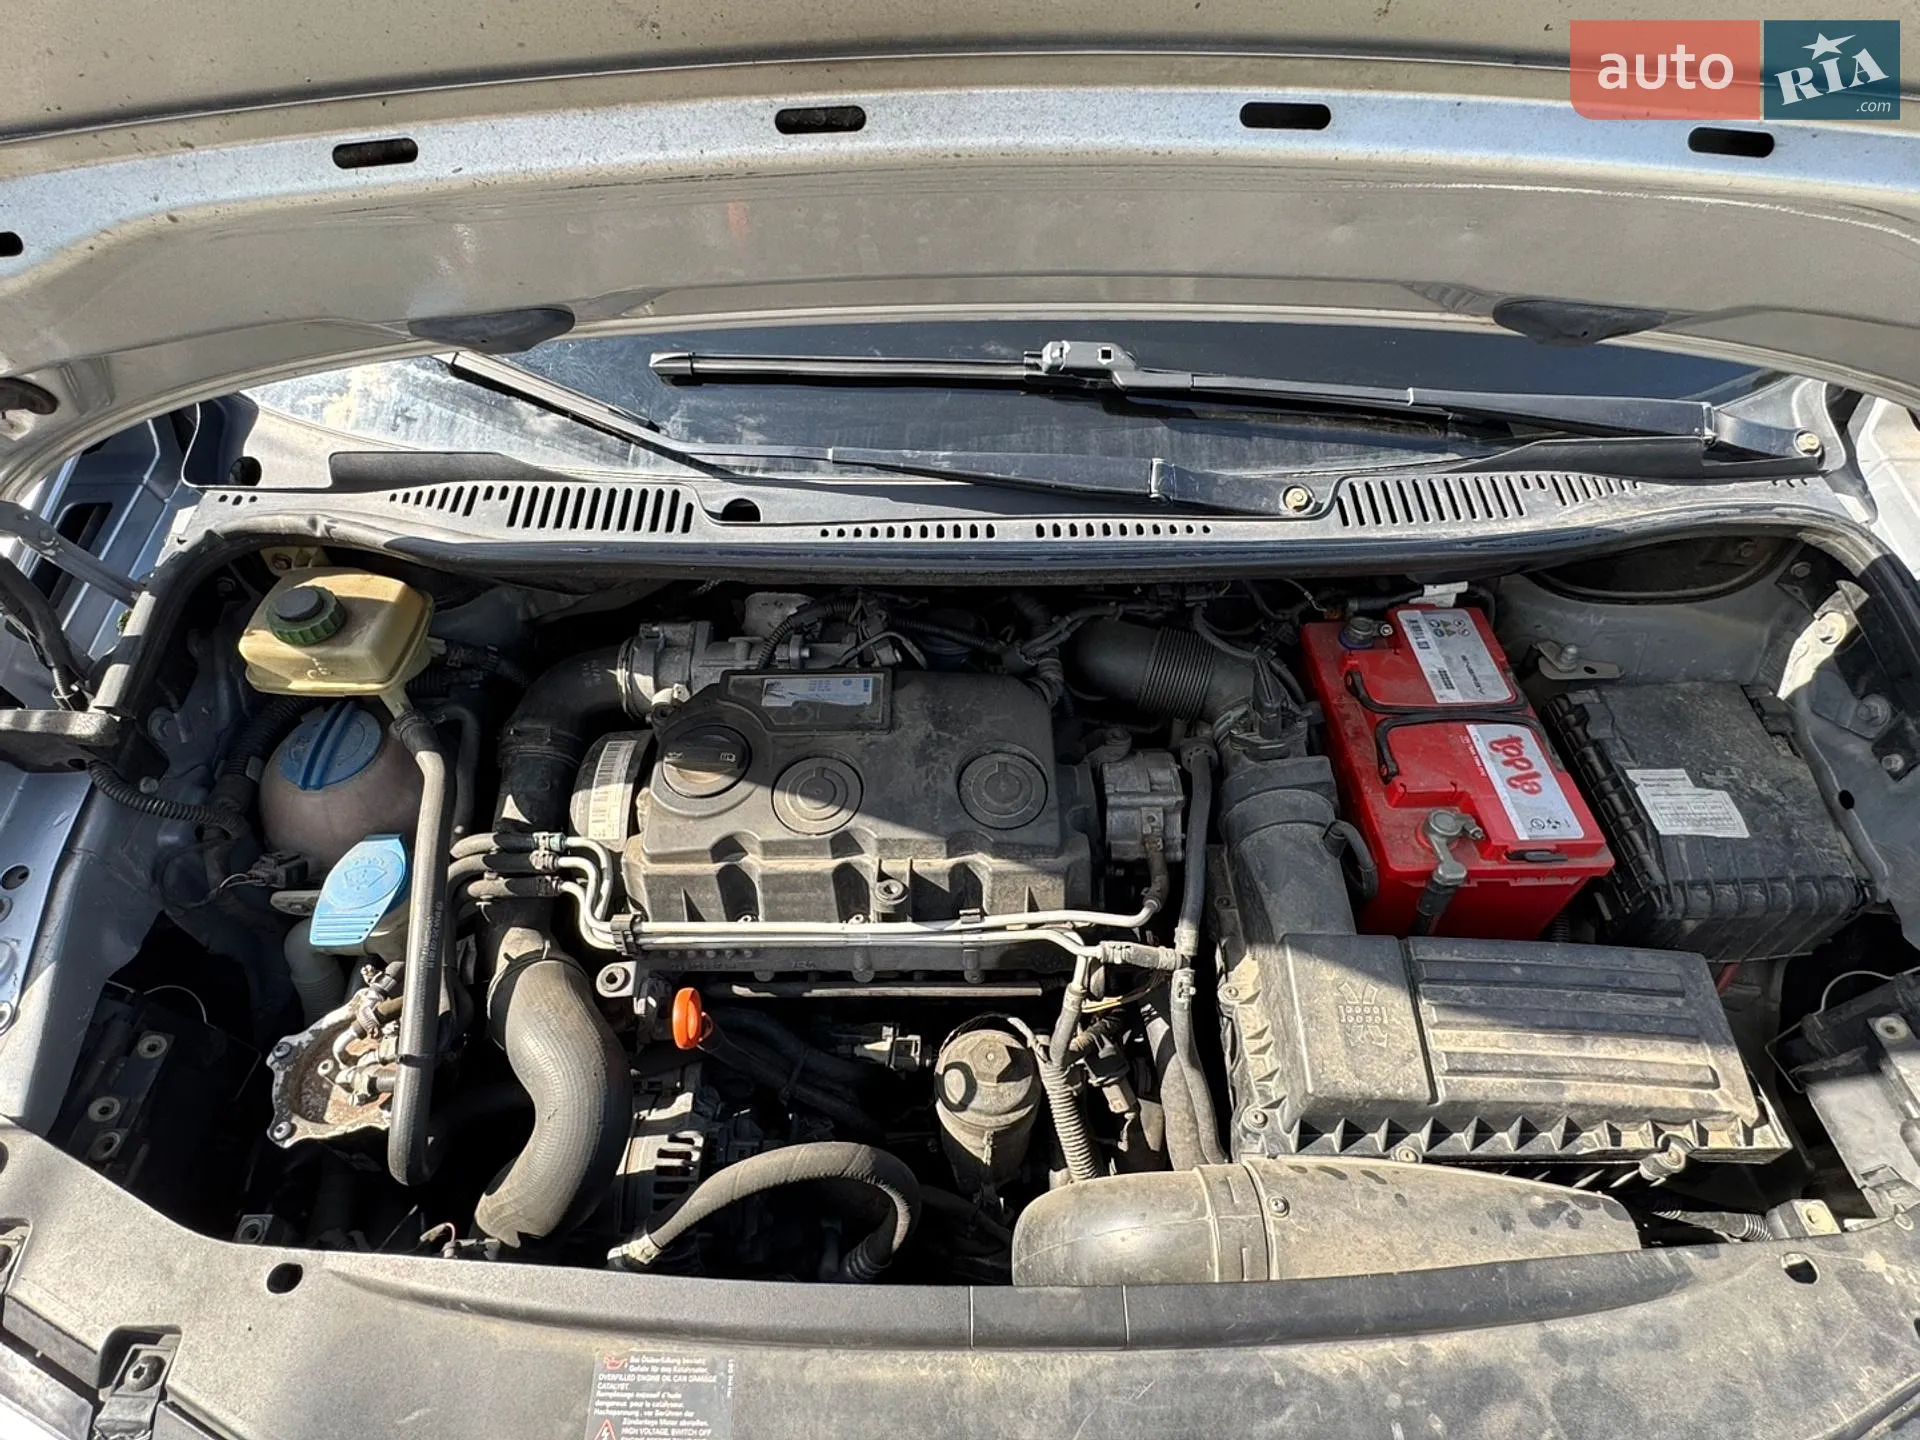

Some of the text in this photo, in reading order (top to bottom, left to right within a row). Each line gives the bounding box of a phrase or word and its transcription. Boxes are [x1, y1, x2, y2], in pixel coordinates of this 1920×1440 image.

[598, 1373, 717, 1383] OVERFILLED ENGINE OIL CAN DAMAGE
[621, 1427, 639, 1435] HIGH
